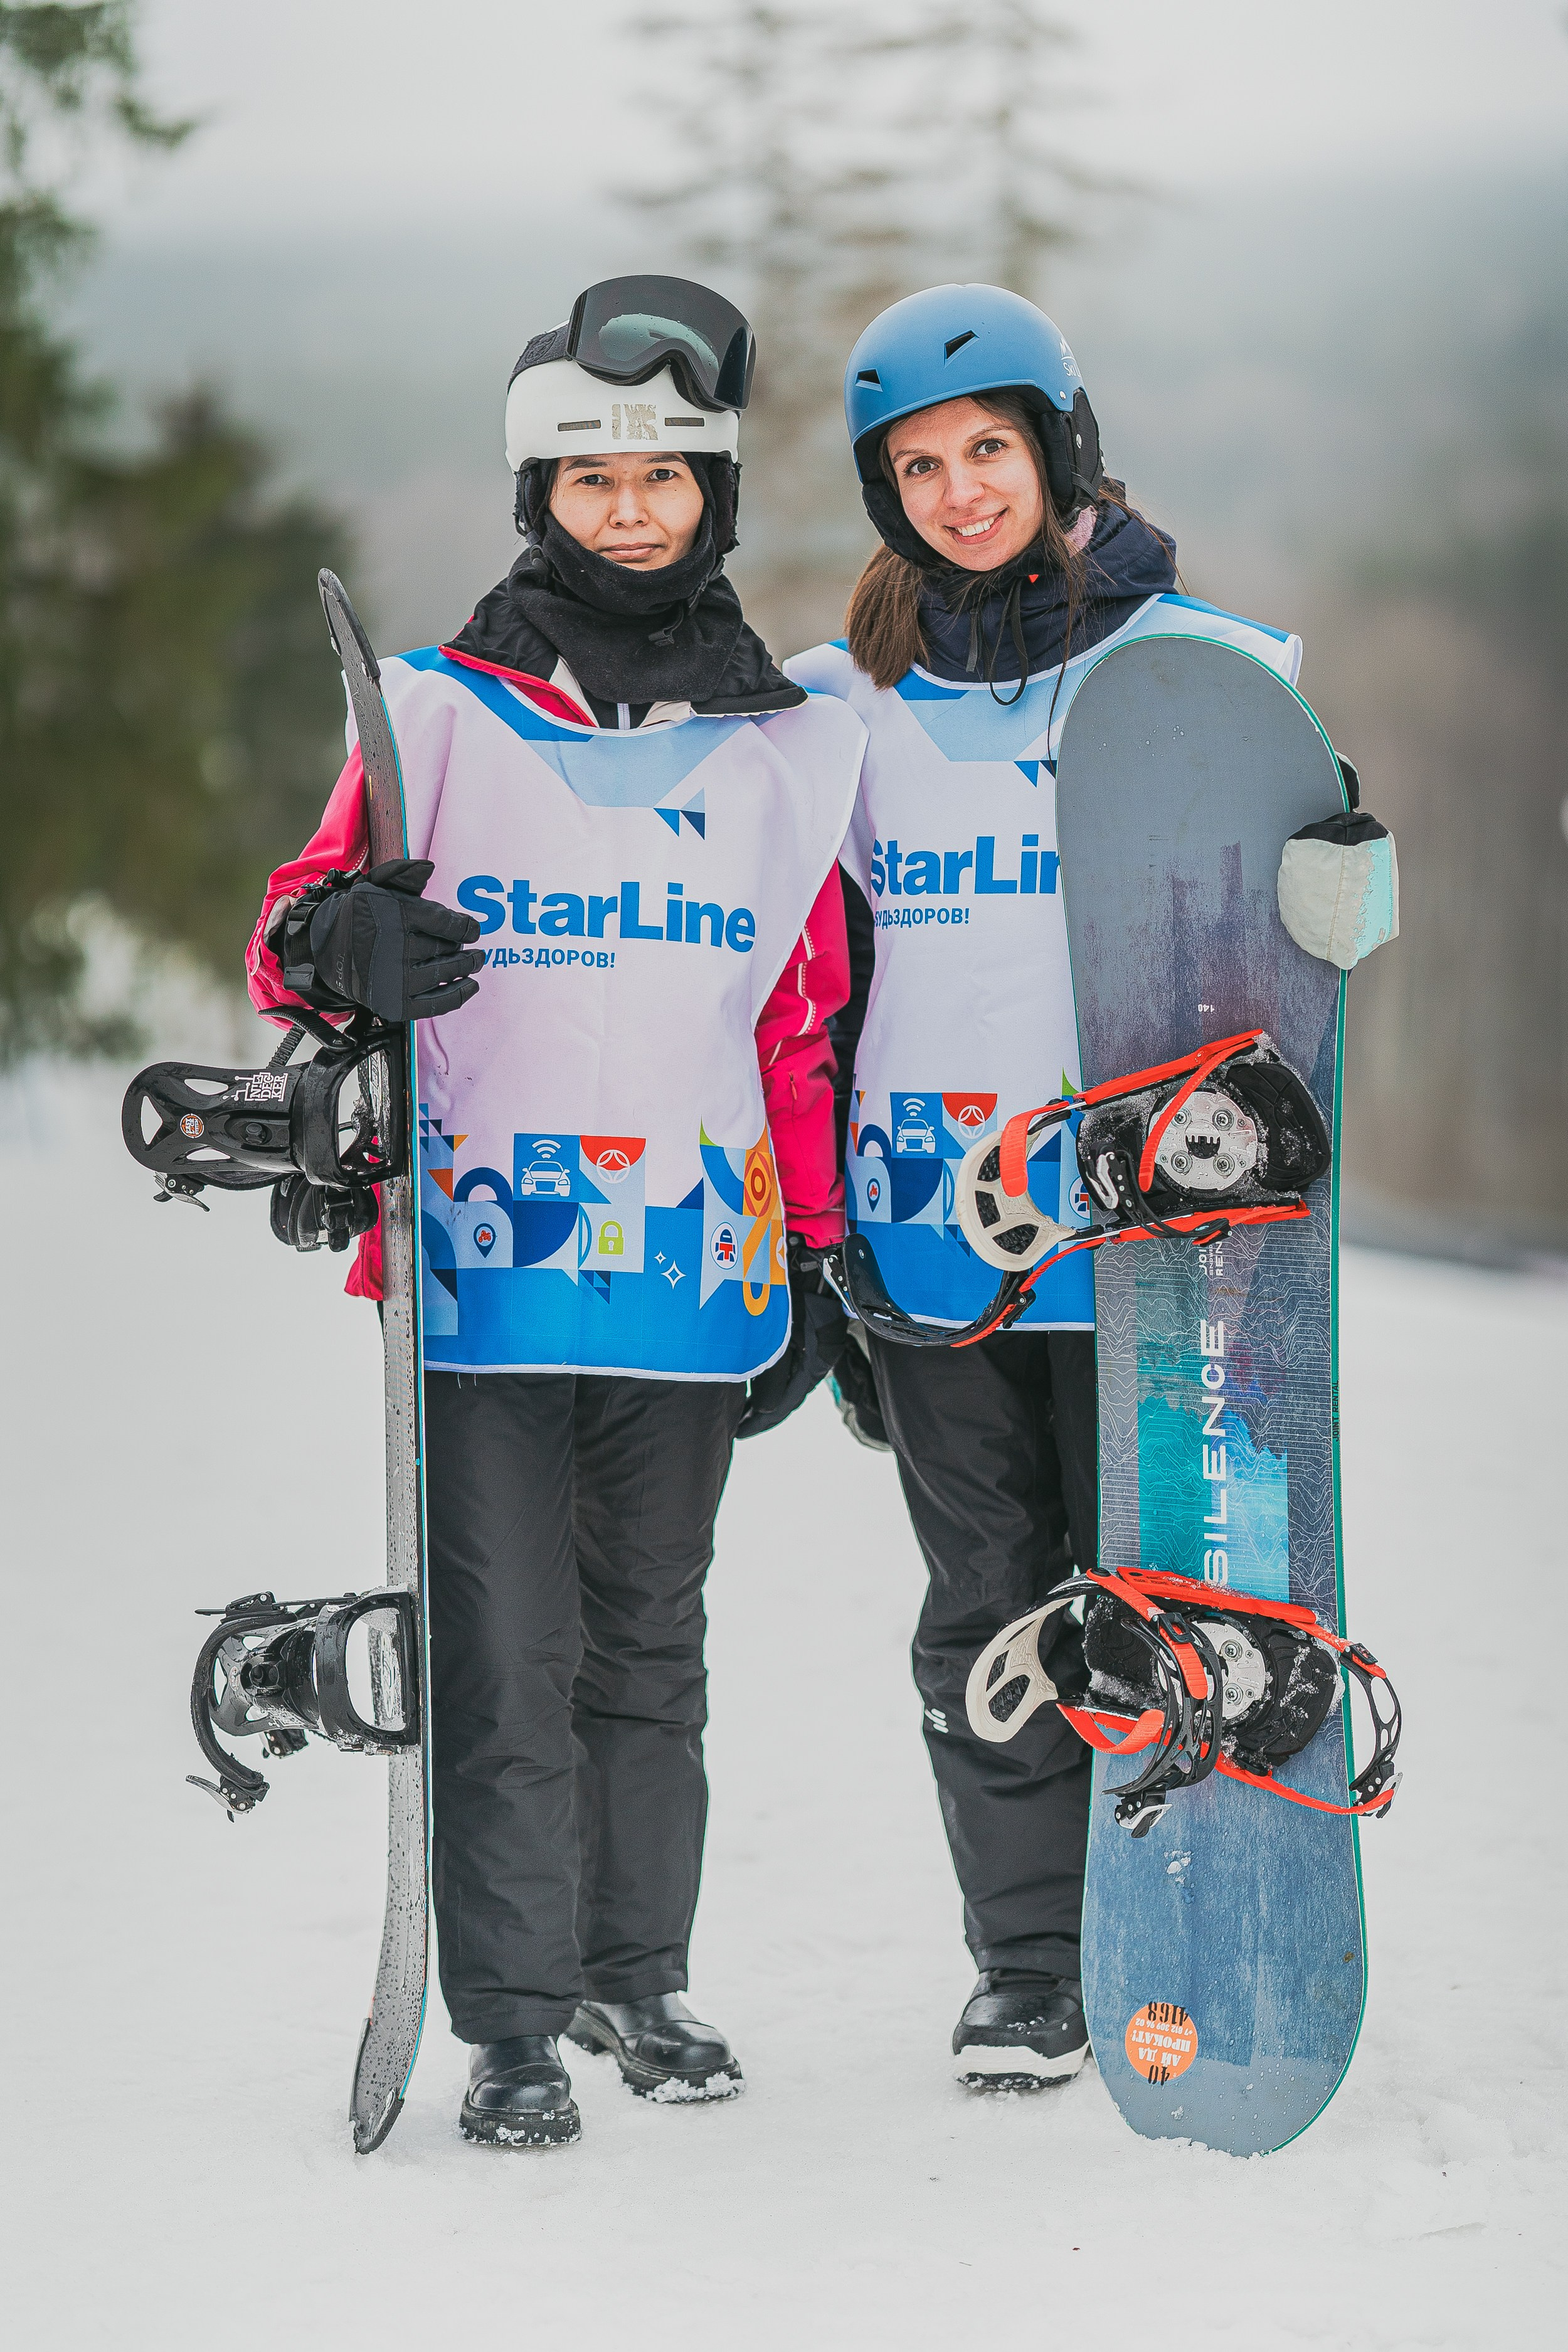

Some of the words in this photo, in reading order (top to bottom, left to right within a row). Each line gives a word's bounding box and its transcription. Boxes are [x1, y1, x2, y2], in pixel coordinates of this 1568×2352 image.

[457, 874, 756, 953] StarLine
[482, 947, 615, 968] УДЬЗДОРОВ!
[1197, 1004, 1215, 1013] 140
[1199, 1248, 1207, 1275] JOI
[1331, 1380, 1340, 1412] RENTAL
[1331, 1416, 1340, 1442] JOINT
[1200, 1319, 1229, 1589] SILENCE
[1147, 2001, 1190, 2026] 4168
[1131, 2029, 1192, 2053] ПРОКАТ!
[1138, 2047, 1158, 2062] ДА
[1160, 2051, 1182, 2067] АЙ
[1147, 2065, 1170, 2086] 40
